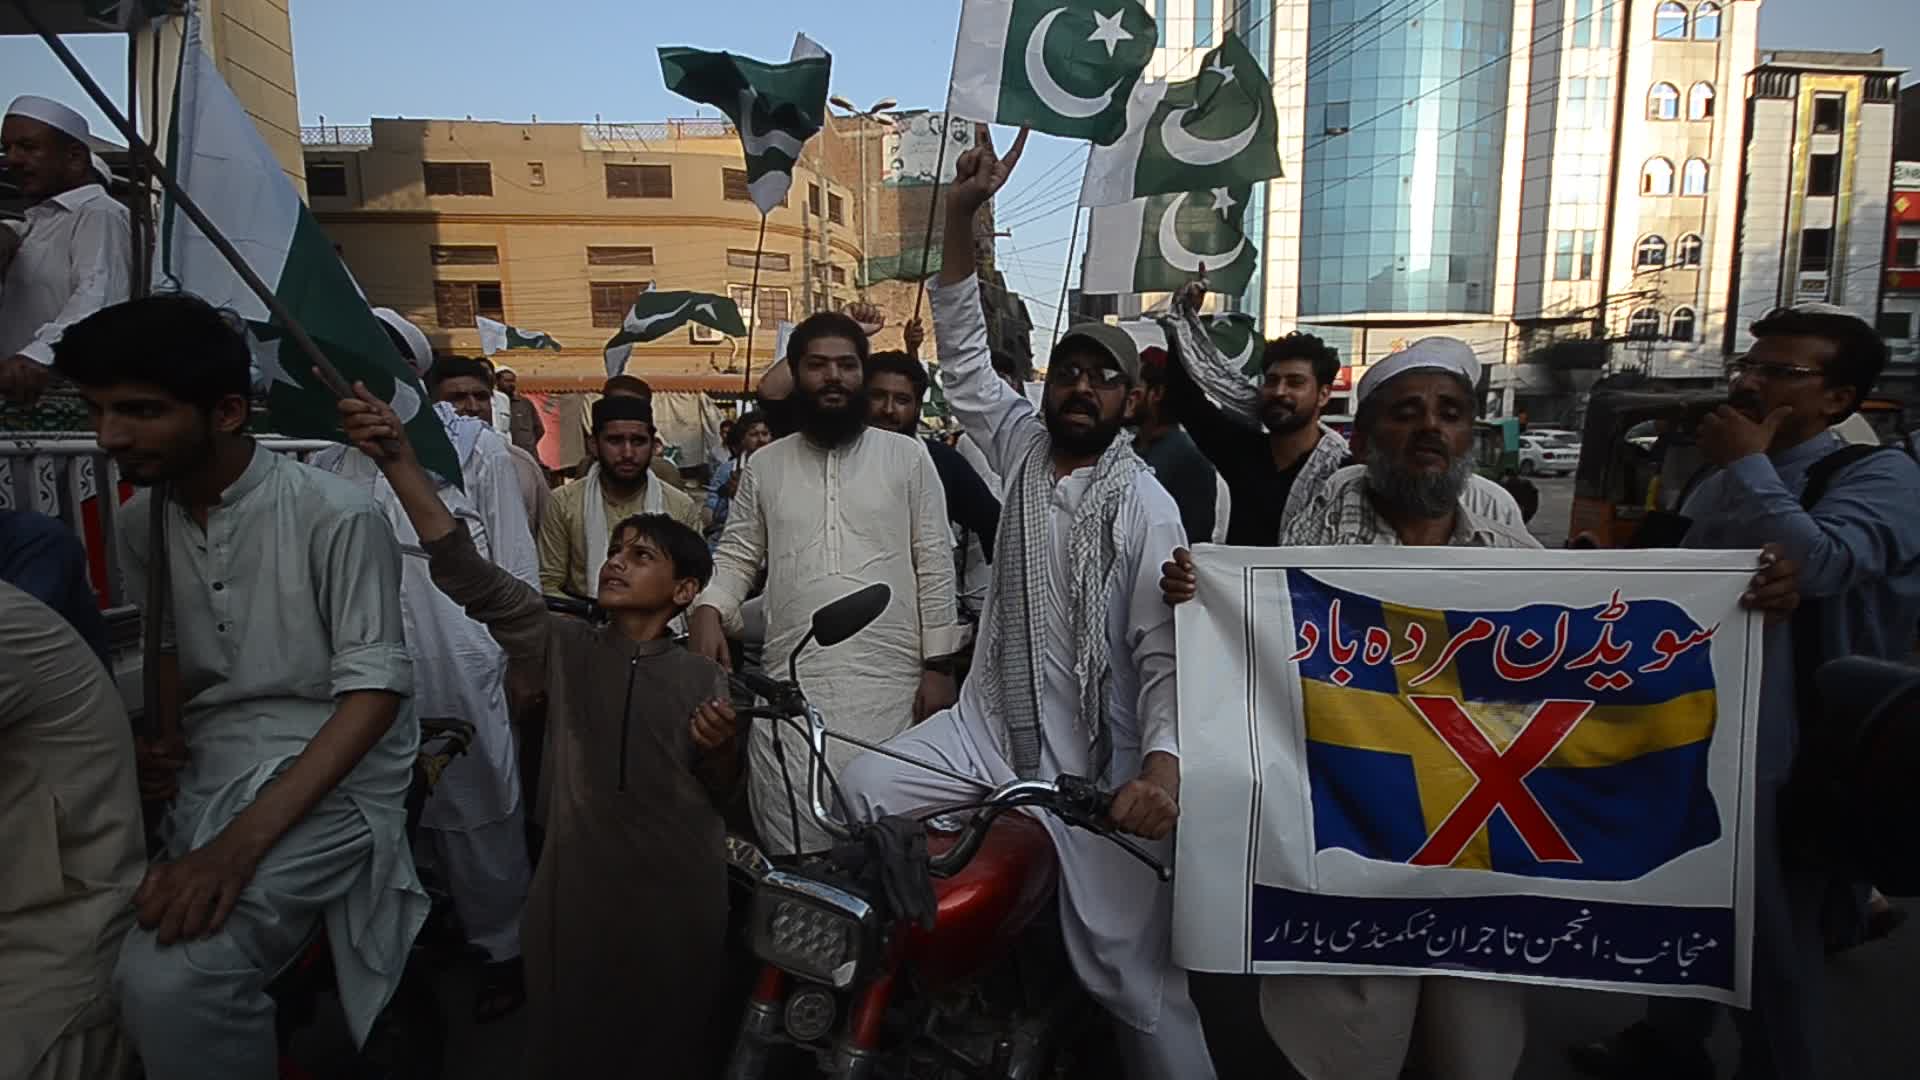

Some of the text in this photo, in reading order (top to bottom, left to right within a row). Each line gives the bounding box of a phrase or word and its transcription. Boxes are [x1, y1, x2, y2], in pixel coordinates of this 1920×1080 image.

[1493, 587, 1720, 691] سویڈن
[1264, 920, 1326, 954] بازار
[1426, 924, 1524, 957] تاجران
[1524, 908, 1598, 964] انجمن
